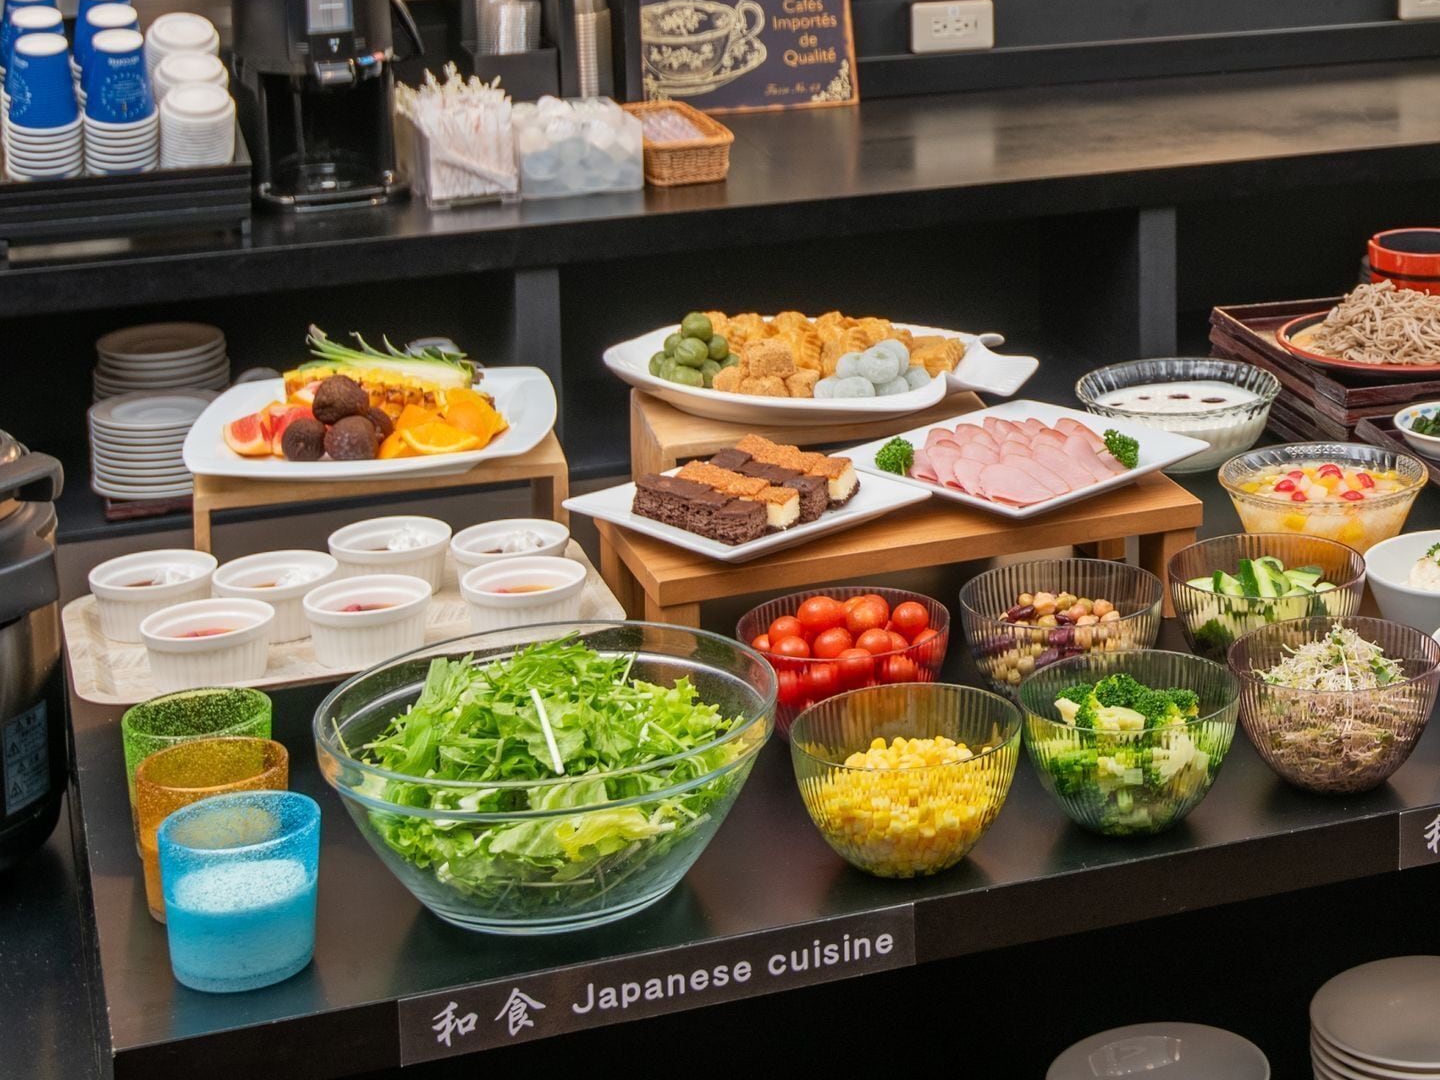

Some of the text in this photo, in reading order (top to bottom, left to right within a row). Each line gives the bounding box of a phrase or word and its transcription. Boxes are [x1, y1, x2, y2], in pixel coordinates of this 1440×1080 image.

[772, 12, 838, 33] Importés
[798, 31, 818, 47] de
[782, 46, 837, 69] Qualité
[430, 930, 895, 1049] 和食 Japanese cuisine
